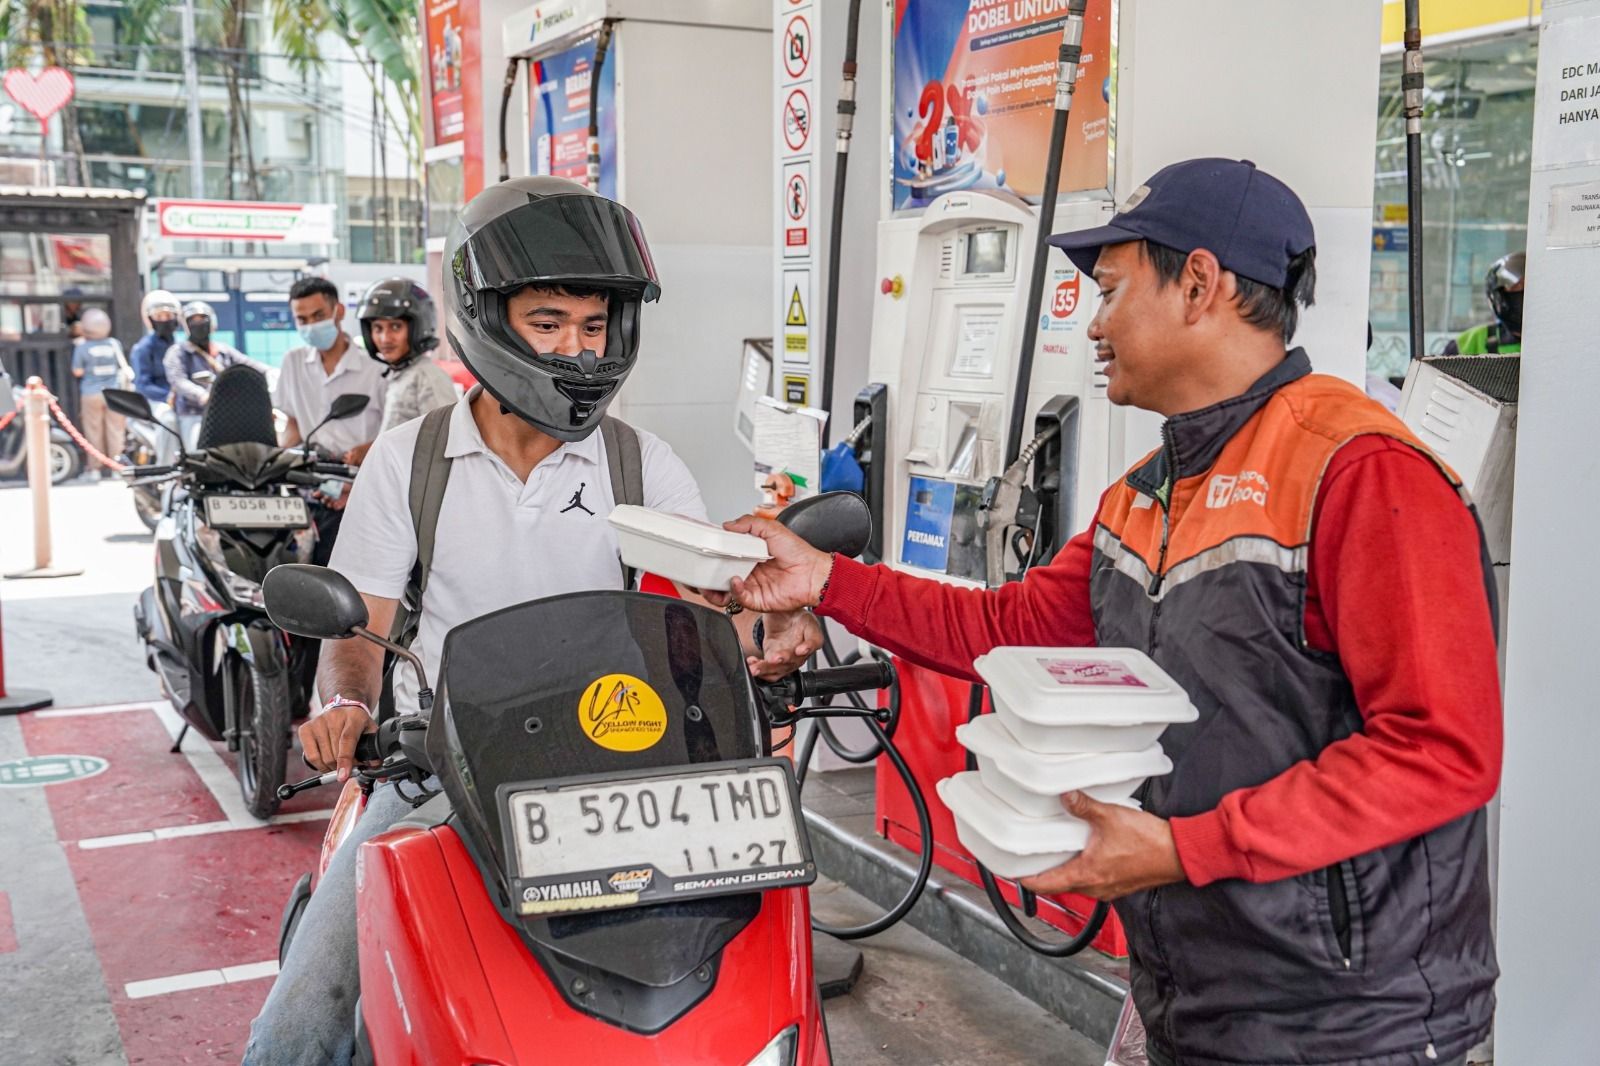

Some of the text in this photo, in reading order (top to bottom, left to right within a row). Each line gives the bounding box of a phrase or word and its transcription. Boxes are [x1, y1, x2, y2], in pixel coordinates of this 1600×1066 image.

[968, 4, 1011, 33] DOBEL
[1562, 62, 1600, 80] EDC M
[1560, 87, 1587, 102] DARI
[1559, 108, 1599, 125] HANYA
[1051, 288, 1076, 313] 135
[212, 500, 220, 510] B
[907, 530, 945, 548] PERTAMAX
[524, 778, 782, 845] B 5204 TMD
[540, 879, 602, 901] YAMAHA
[673, 876, 740, 892] SEMAKIN
[757, 868, 805, 882] DEPAN
